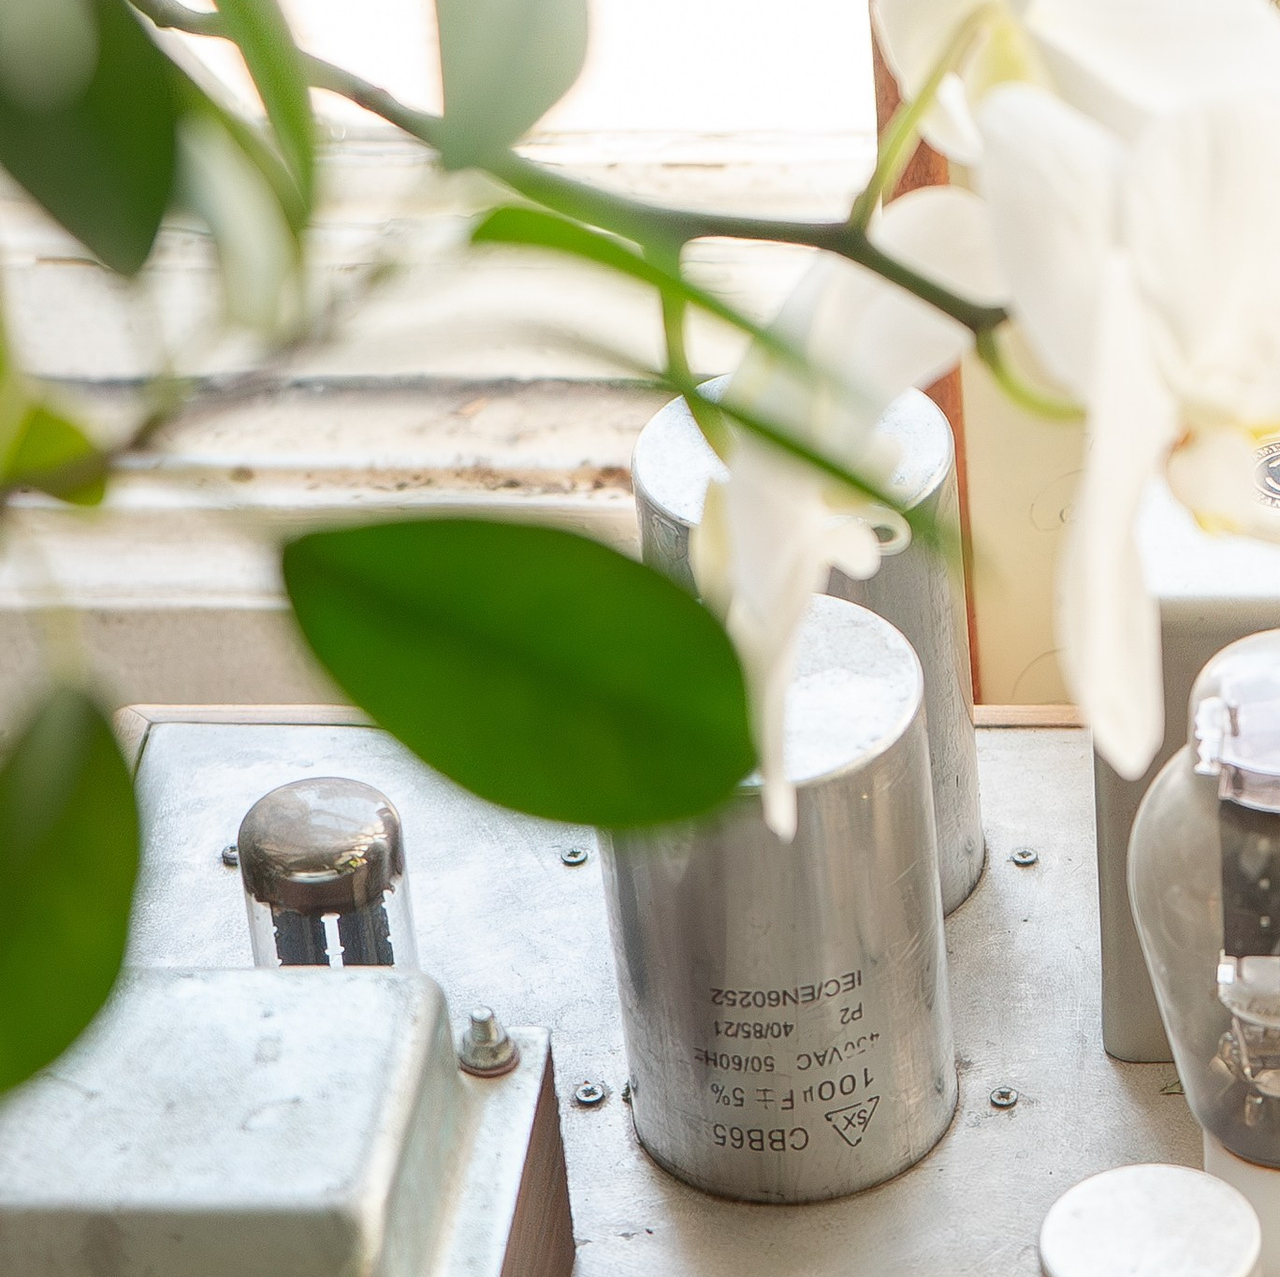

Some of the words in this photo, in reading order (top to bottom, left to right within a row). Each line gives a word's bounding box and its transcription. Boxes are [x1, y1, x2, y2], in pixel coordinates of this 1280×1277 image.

[710, 969, 863, 1009] IEC/EN60252
[839, 1002, 864, 1025] P2
[713, 1020, 795, 1040] 40/85/21
[711, 1083, 745, 1108] 5%
[843, 1109, 868, 1131] SX
[712, 1123, 810, 1152] CBB65
